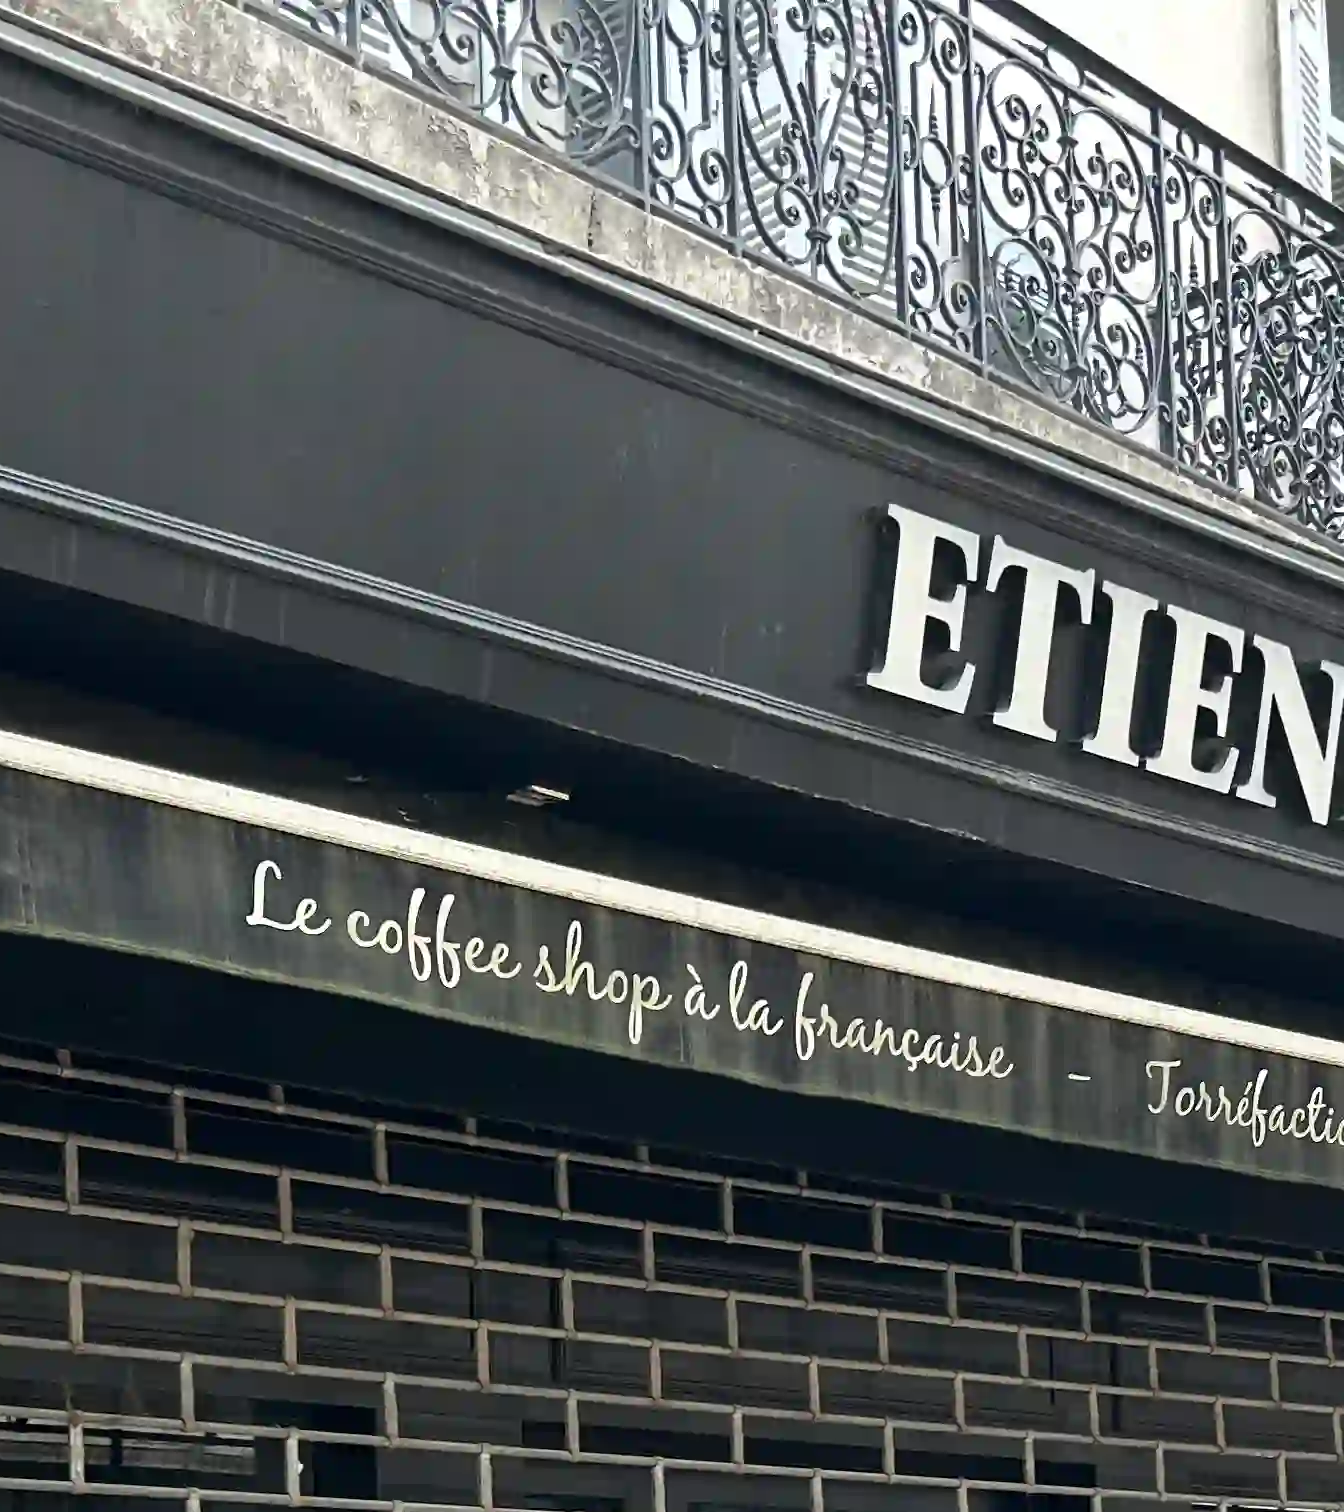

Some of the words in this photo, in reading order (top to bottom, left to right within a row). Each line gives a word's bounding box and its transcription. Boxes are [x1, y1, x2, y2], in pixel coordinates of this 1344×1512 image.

[246, 860, 331, 935] Le
[347, 888, 522, 988] coffee
[534, 920, 673, 1045] shop
[684, 963, 720, 1020] à
[729, 960, 784, 1037] la
[795, 971, 1014, 1078] française
